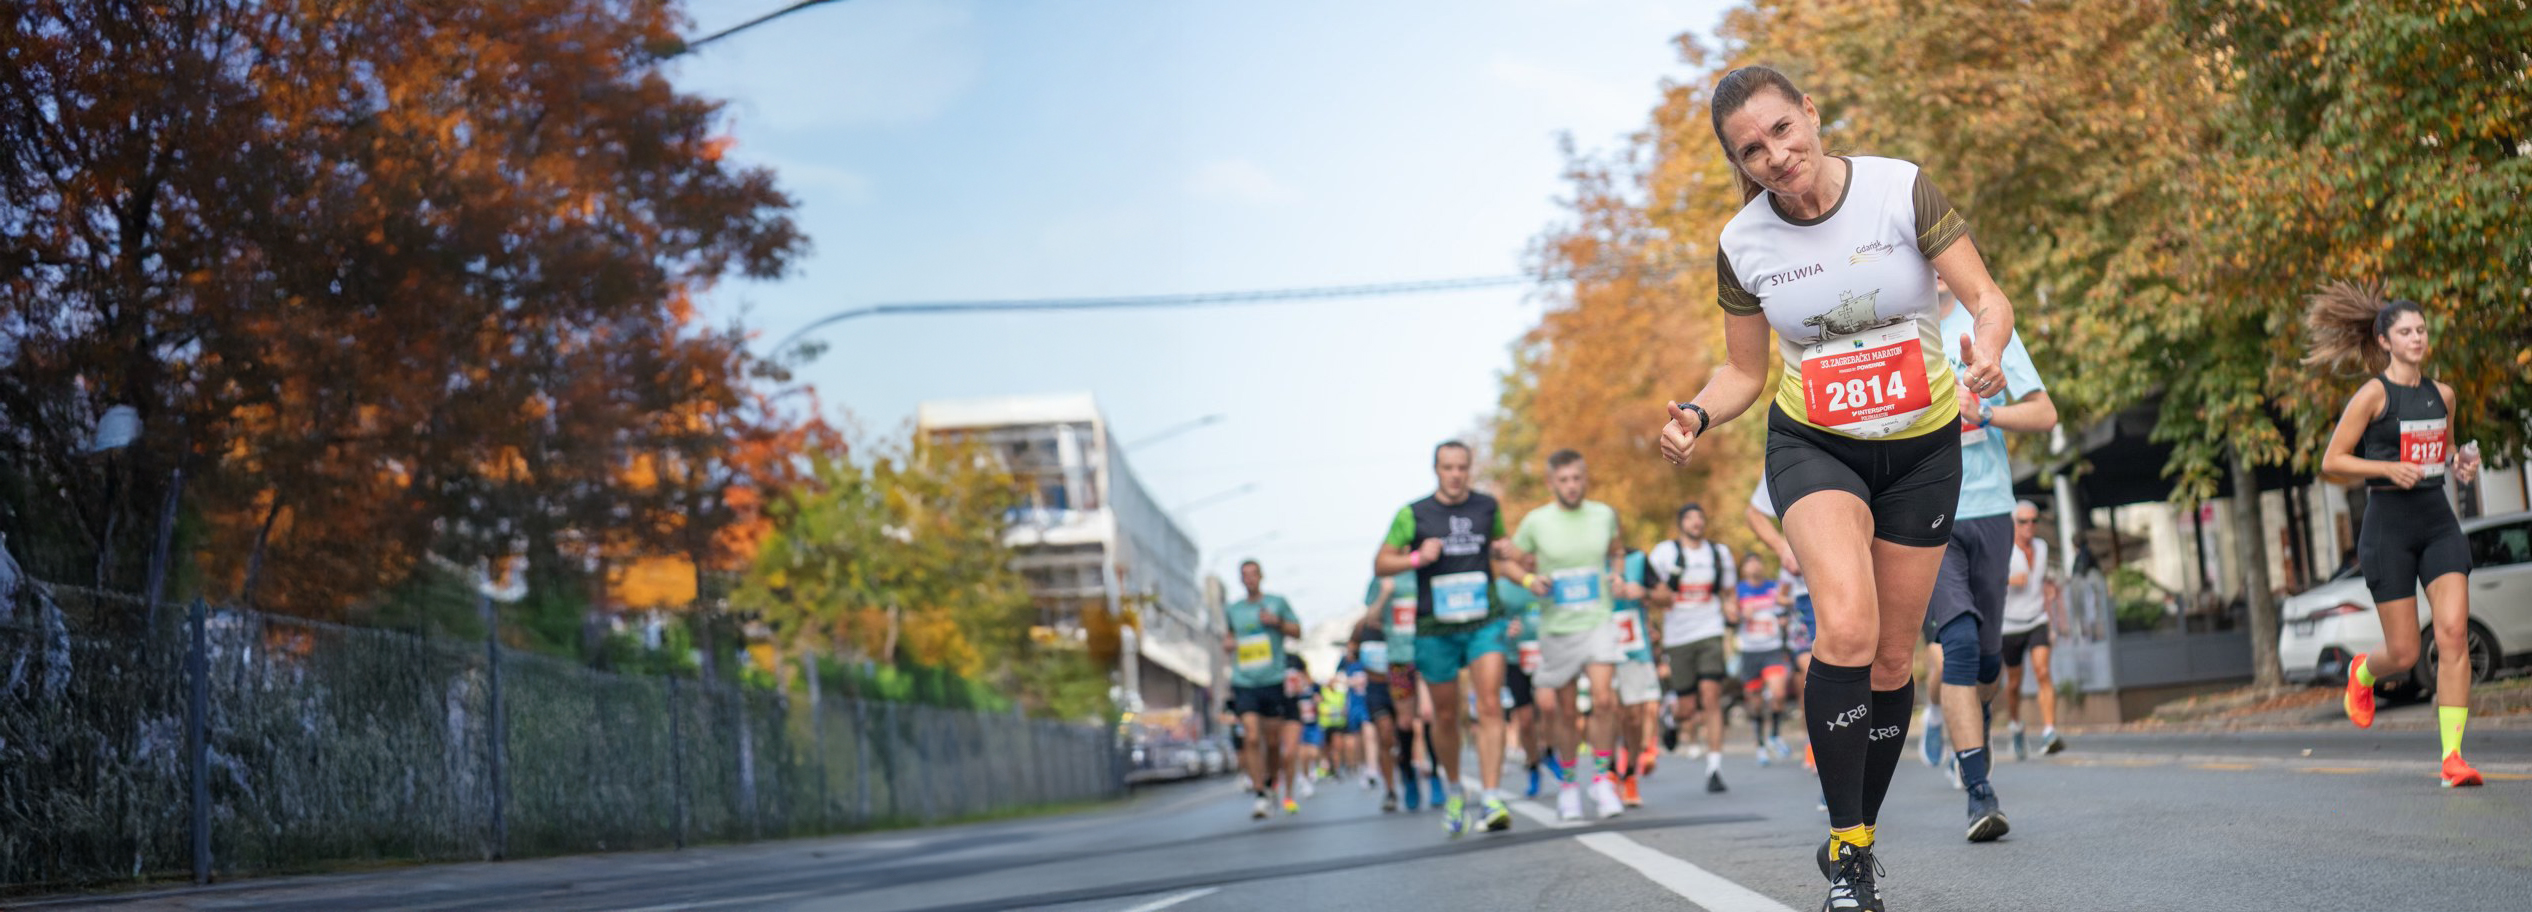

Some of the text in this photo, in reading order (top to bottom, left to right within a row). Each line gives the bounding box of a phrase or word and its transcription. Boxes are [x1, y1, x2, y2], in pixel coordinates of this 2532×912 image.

[1856, 240, 1882, 254] Gdańsk
[1771, 263, 1824, 287] SYLWIA
[1871, 346, 1903, 361] MARATON
[1825, 370, 1907, 412] 2814
[1857, 403, 1895, 416] INTERSPORT
[2411, 441, 2444, 459] 2127
